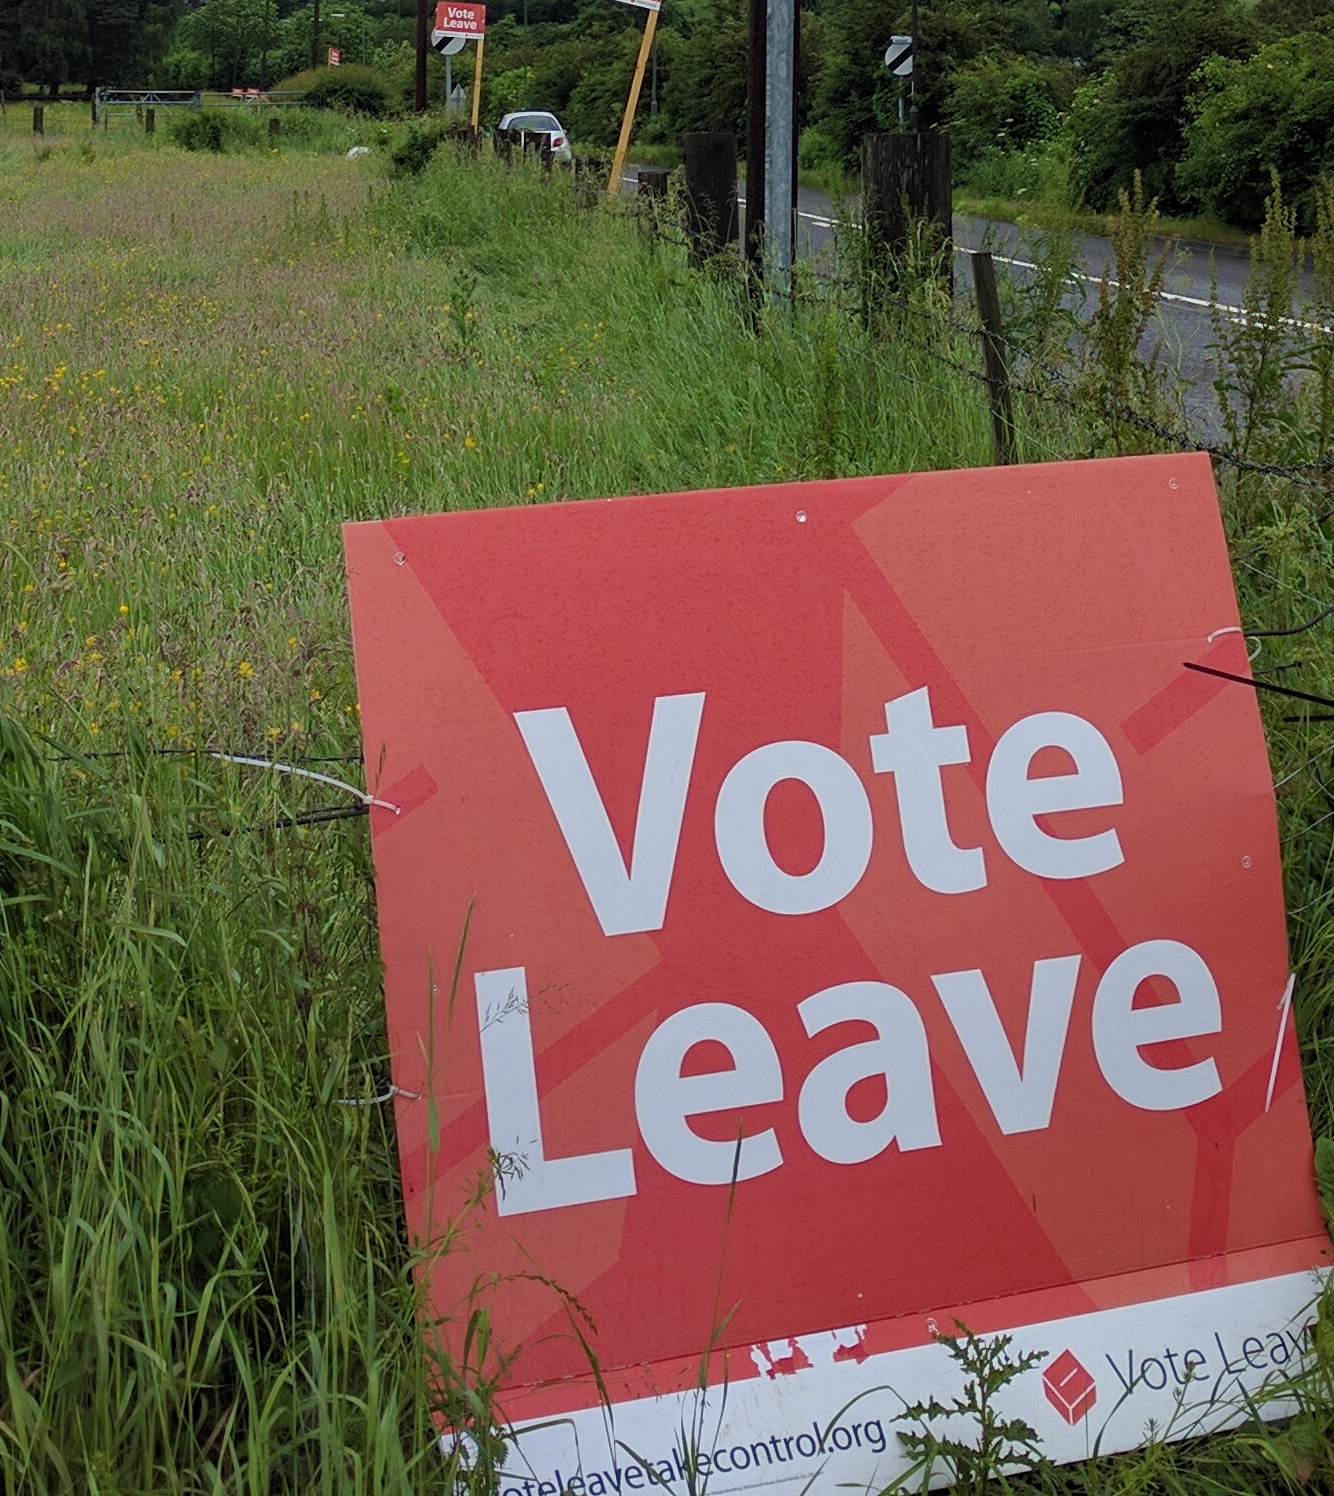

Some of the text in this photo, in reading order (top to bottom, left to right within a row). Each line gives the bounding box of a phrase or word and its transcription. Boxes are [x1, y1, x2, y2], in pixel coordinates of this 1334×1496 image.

[443, 17, 478, 30] Leave
[448, 7, 475, 20] Vote
[513, 686, 1124, 936] Vote
[474, 940, 1223, 1216] Leave
[1105, 1330, 1307, 1394] Vote Leav
[495, 1419, 887, 1496] teleavetakecontrol.org
